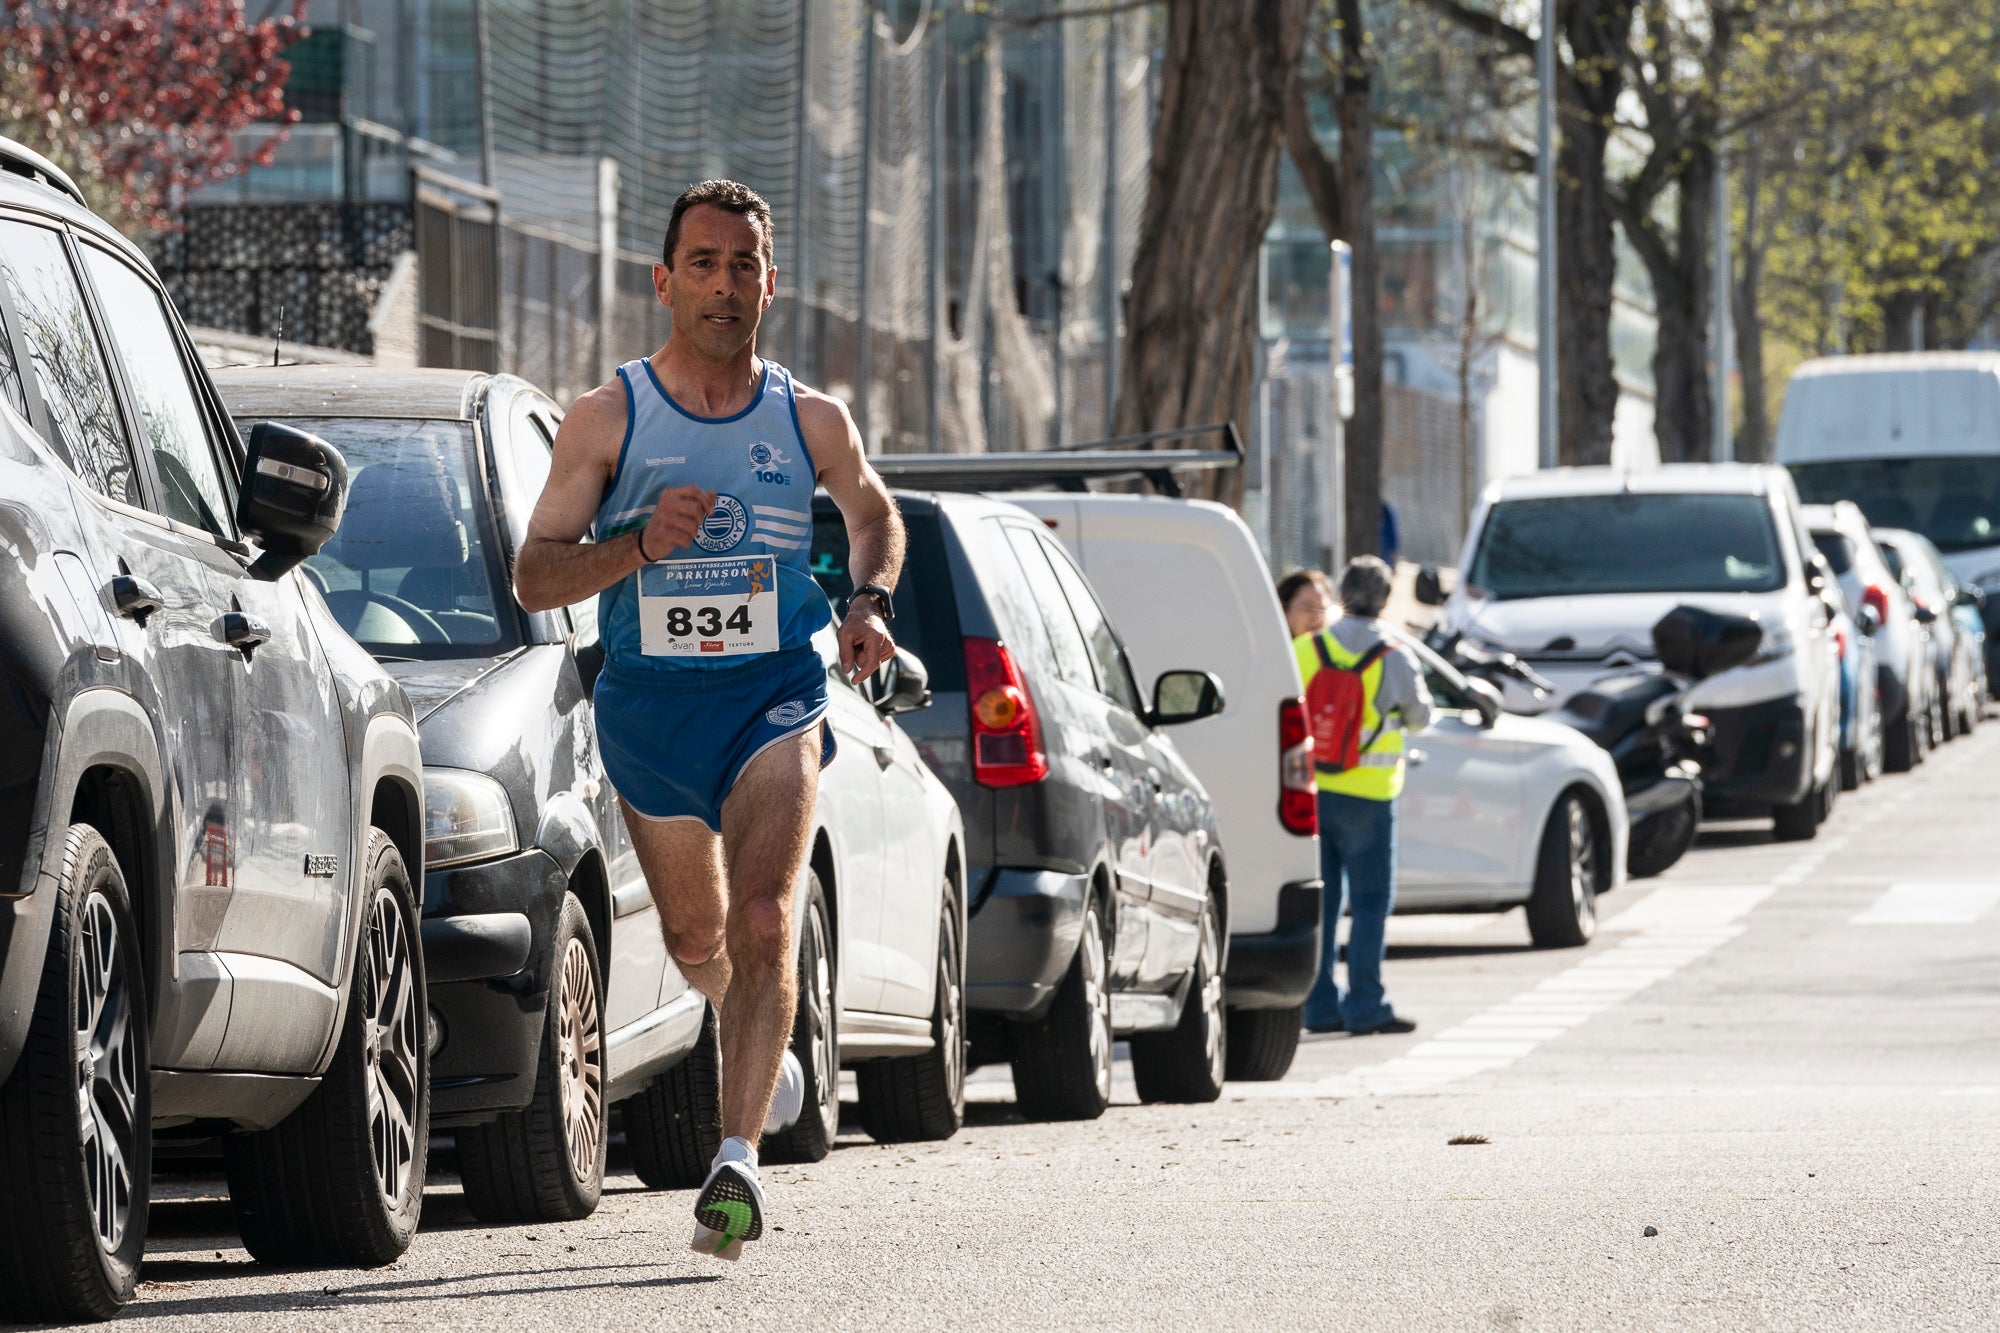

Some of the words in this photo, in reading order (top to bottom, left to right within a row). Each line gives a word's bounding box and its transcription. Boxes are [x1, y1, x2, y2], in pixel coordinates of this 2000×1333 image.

[756, 471, 784, 484] 100
[700, 536, 738, 551] SABADELL
[666, 568, 749, 580] PARKINSON
[667, 605, 752, 637] 834
[672, 642, 695, 650] avan
